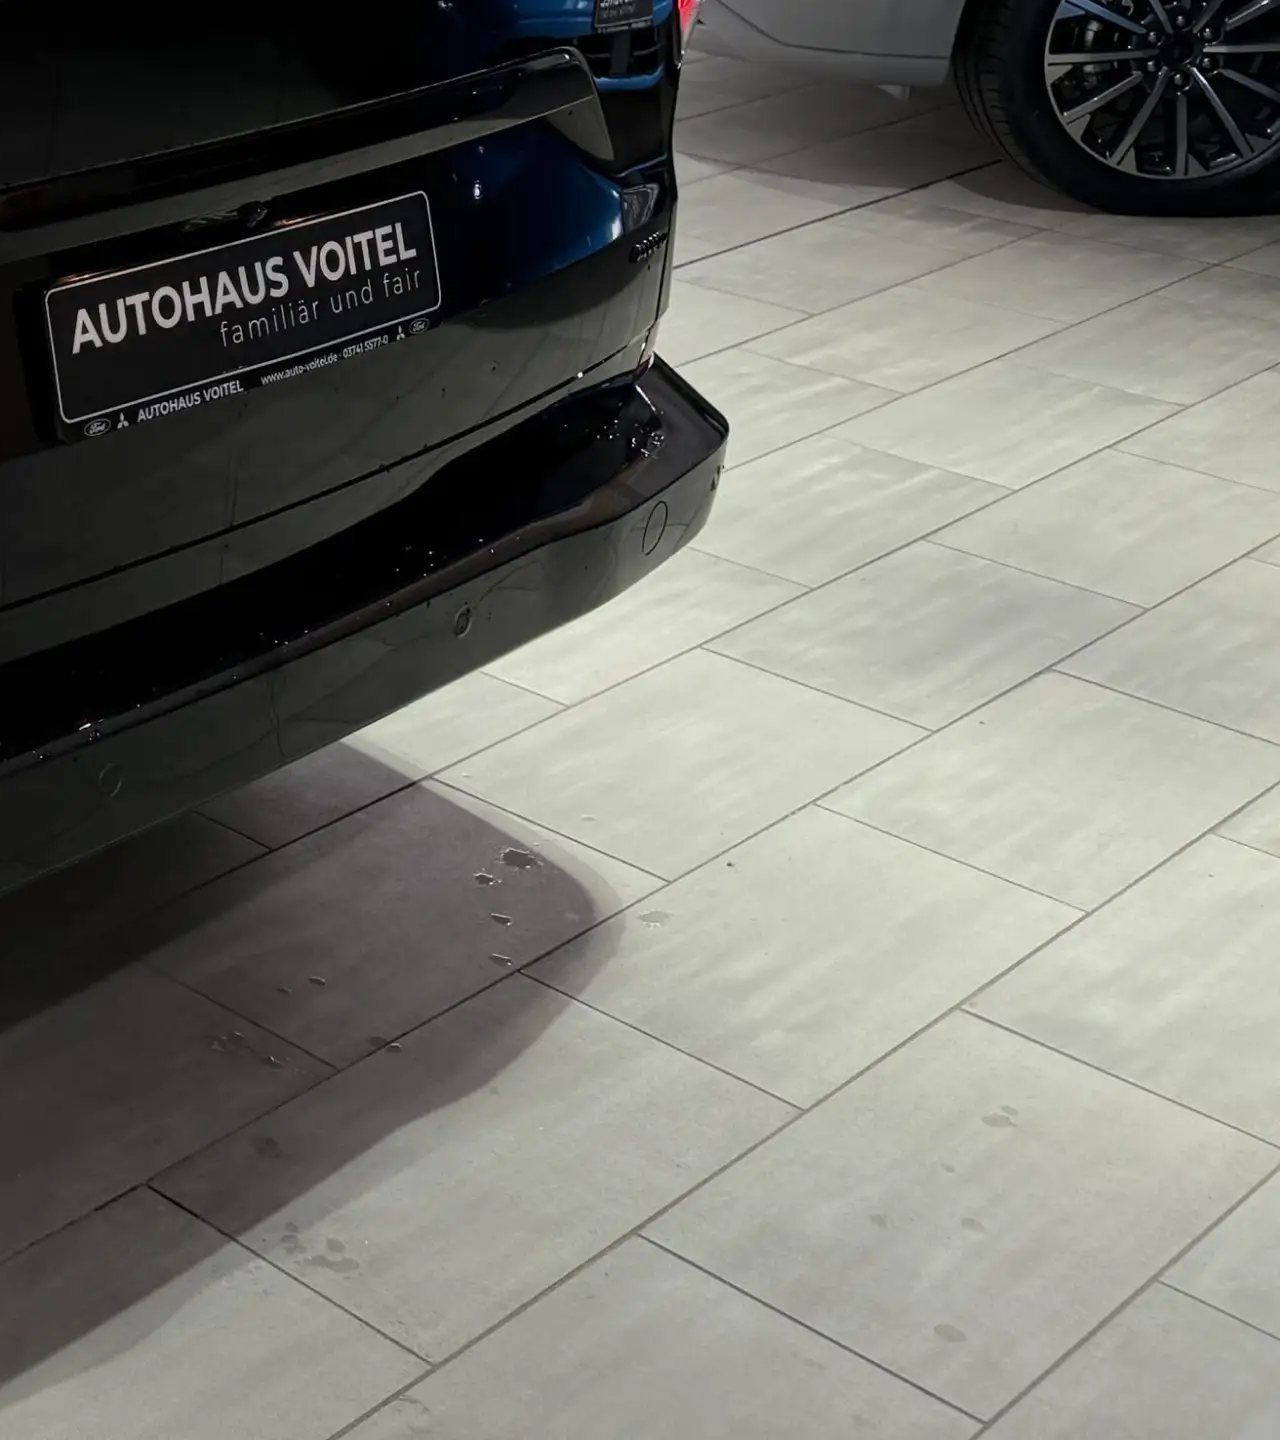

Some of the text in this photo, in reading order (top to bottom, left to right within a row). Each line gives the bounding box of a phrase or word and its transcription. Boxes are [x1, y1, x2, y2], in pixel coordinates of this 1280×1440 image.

[72, 221, 417, 355] AUTOHAUS VOITEL
[219, 267, 422, 348] familiär und fair
[342, 343, 364, 359] 03741
[137, 391, 202, 422] AUTOHAUS
[202, 379, 244, 402] VOITEL
